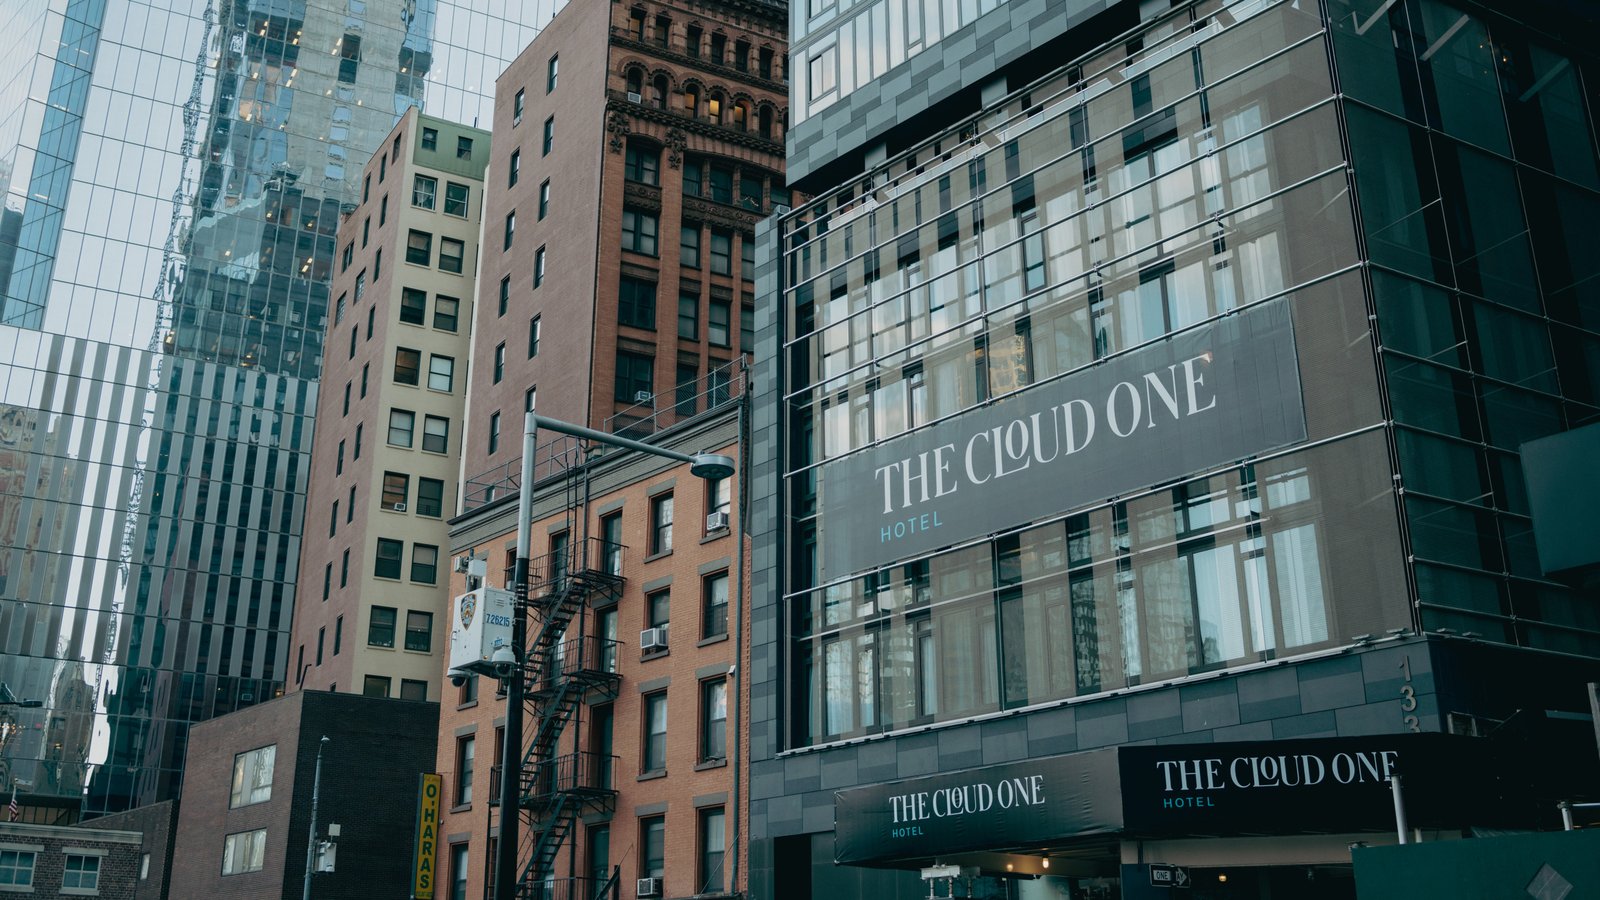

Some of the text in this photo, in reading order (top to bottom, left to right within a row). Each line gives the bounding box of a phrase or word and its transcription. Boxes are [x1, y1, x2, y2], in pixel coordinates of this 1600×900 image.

[875, 353, 1217, 514] THE CLOUD ONE
[880, 510, 943, 543] HOTEL
[486, 613, 510, 627] 726215
[1157, 759, 1225, 791] THE
[1230, 754, 1325, 788] CLOUD
[888, 775, 1045, 823] THE CLOUD ONE
[1163, 797, 1214, 808] HOTEL
[420, 784, 437, 889] O'HARAS
[892, 826, 924, 838] HOTEL
[1156, 871, 1169, 880] ONE
